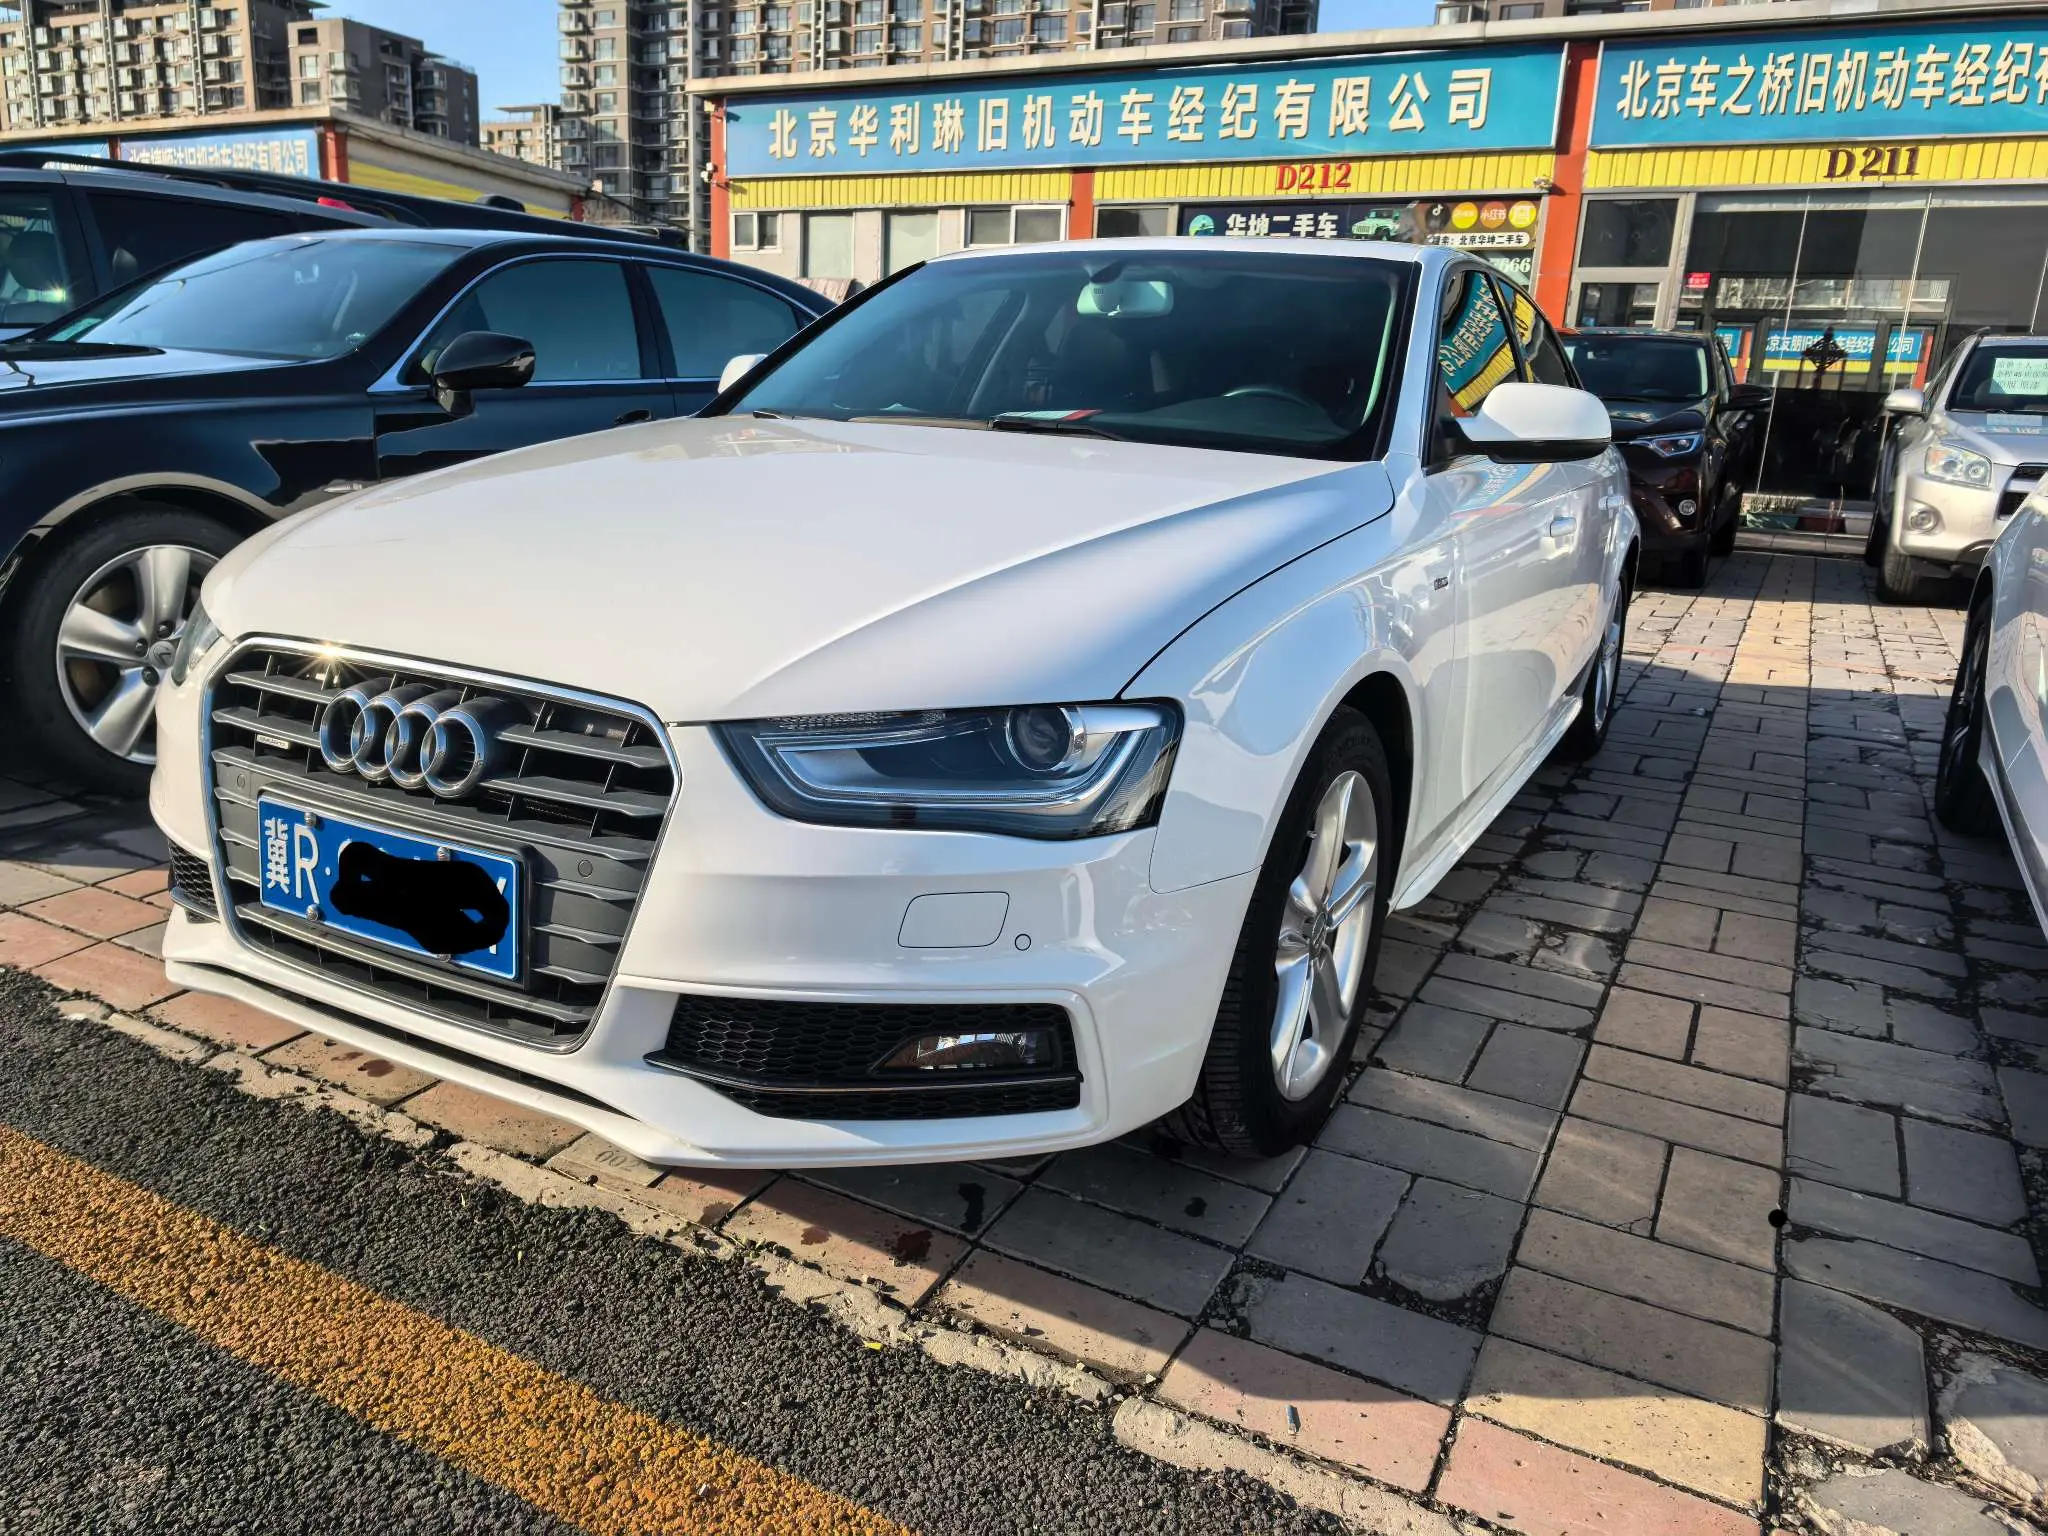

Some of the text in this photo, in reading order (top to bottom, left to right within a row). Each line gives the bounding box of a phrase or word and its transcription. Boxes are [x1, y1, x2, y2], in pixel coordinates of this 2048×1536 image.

[768, 68, 1492, 159] 北京华利琳旧机动车经纪有限公司
[1276, 162, 1352, 191] D212
[1824, 145, 1919, 179] D211
[1225, 212, 1339, 238] 华坤二手车
